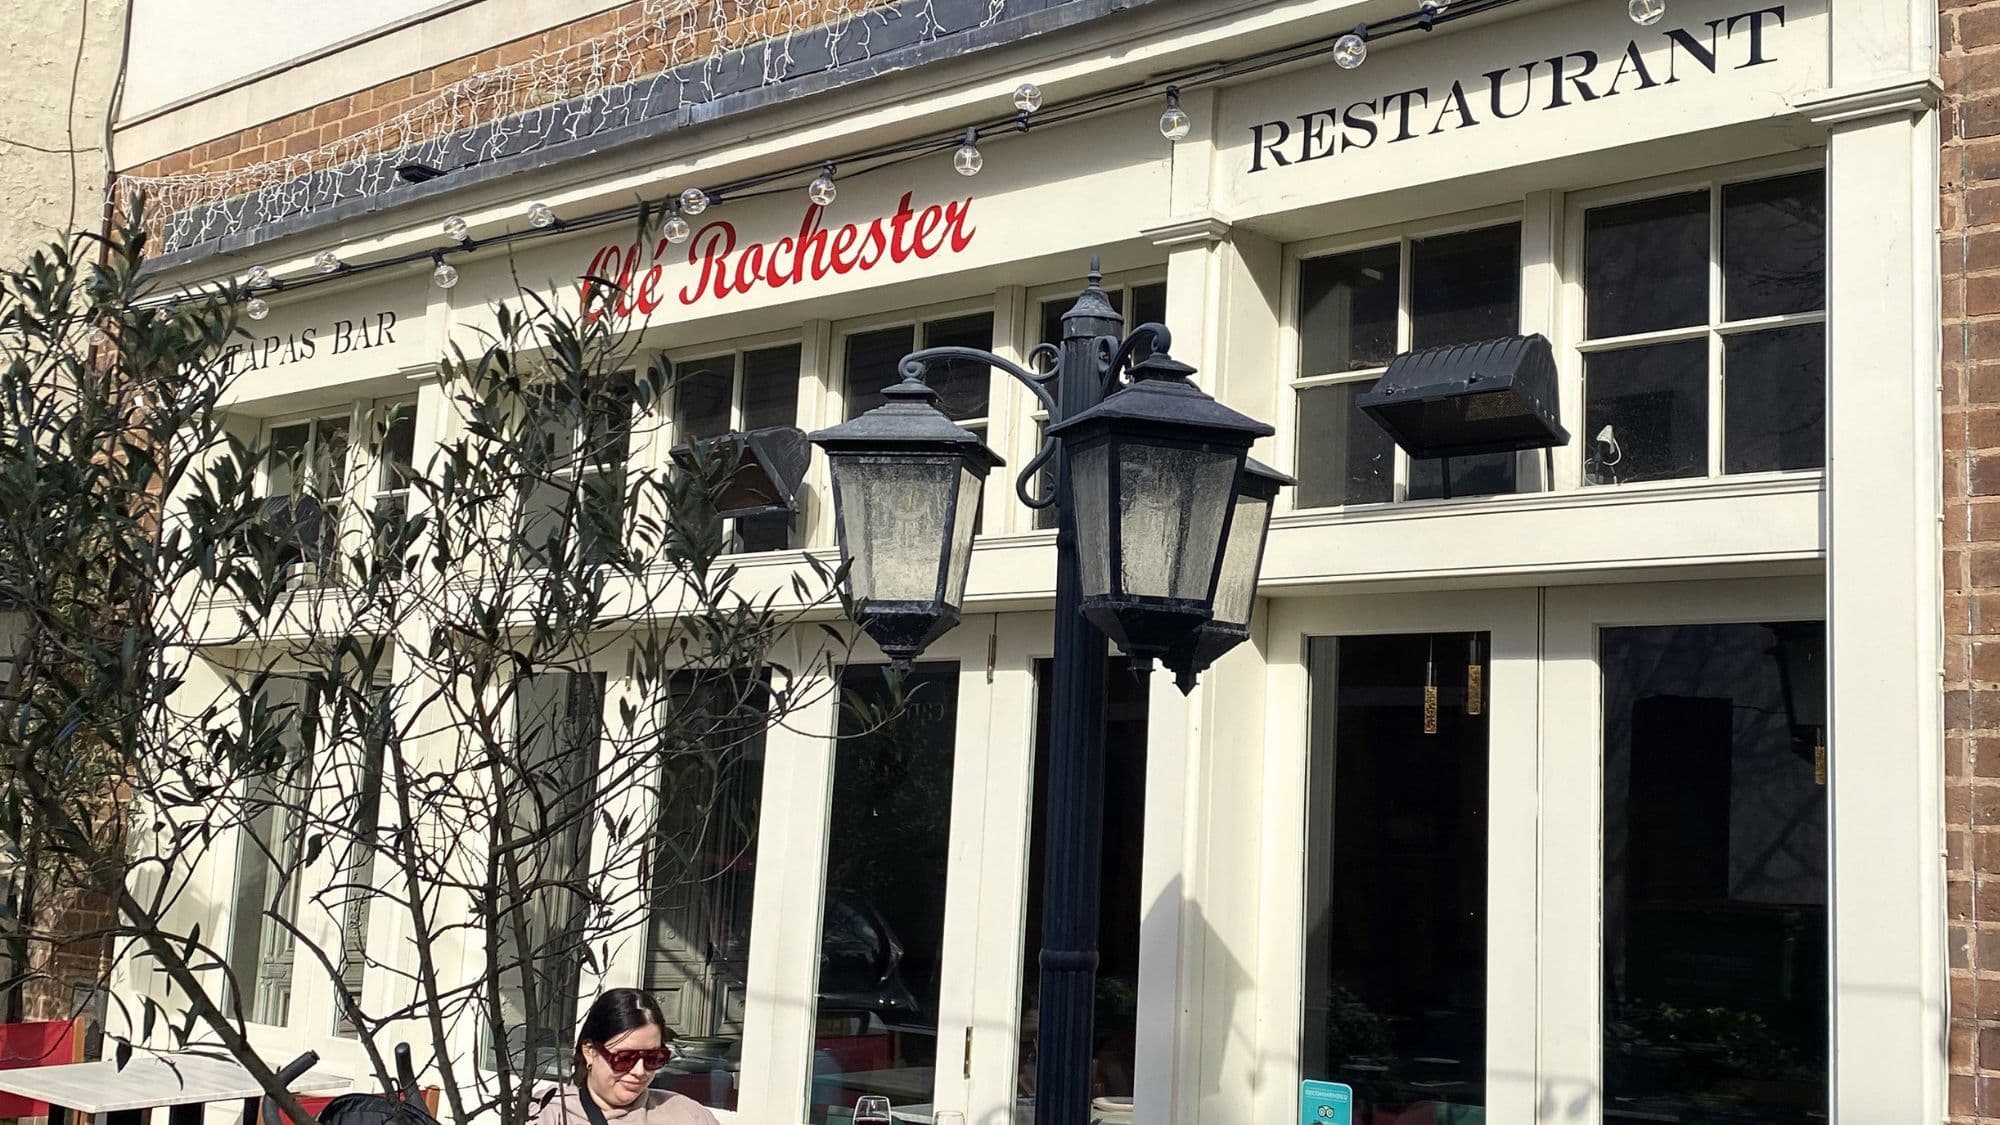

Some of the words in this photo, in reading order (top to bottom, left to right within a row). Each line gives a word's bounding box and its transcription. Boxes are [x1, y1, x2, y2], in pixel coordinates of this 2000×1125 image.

[1247, 5, 1785, 174] RESTAURANT
[679, 190, 977, 305] Rochester
[225, 327, 318, 377] TAPAS
[331, 311, 397, 356] BAR
